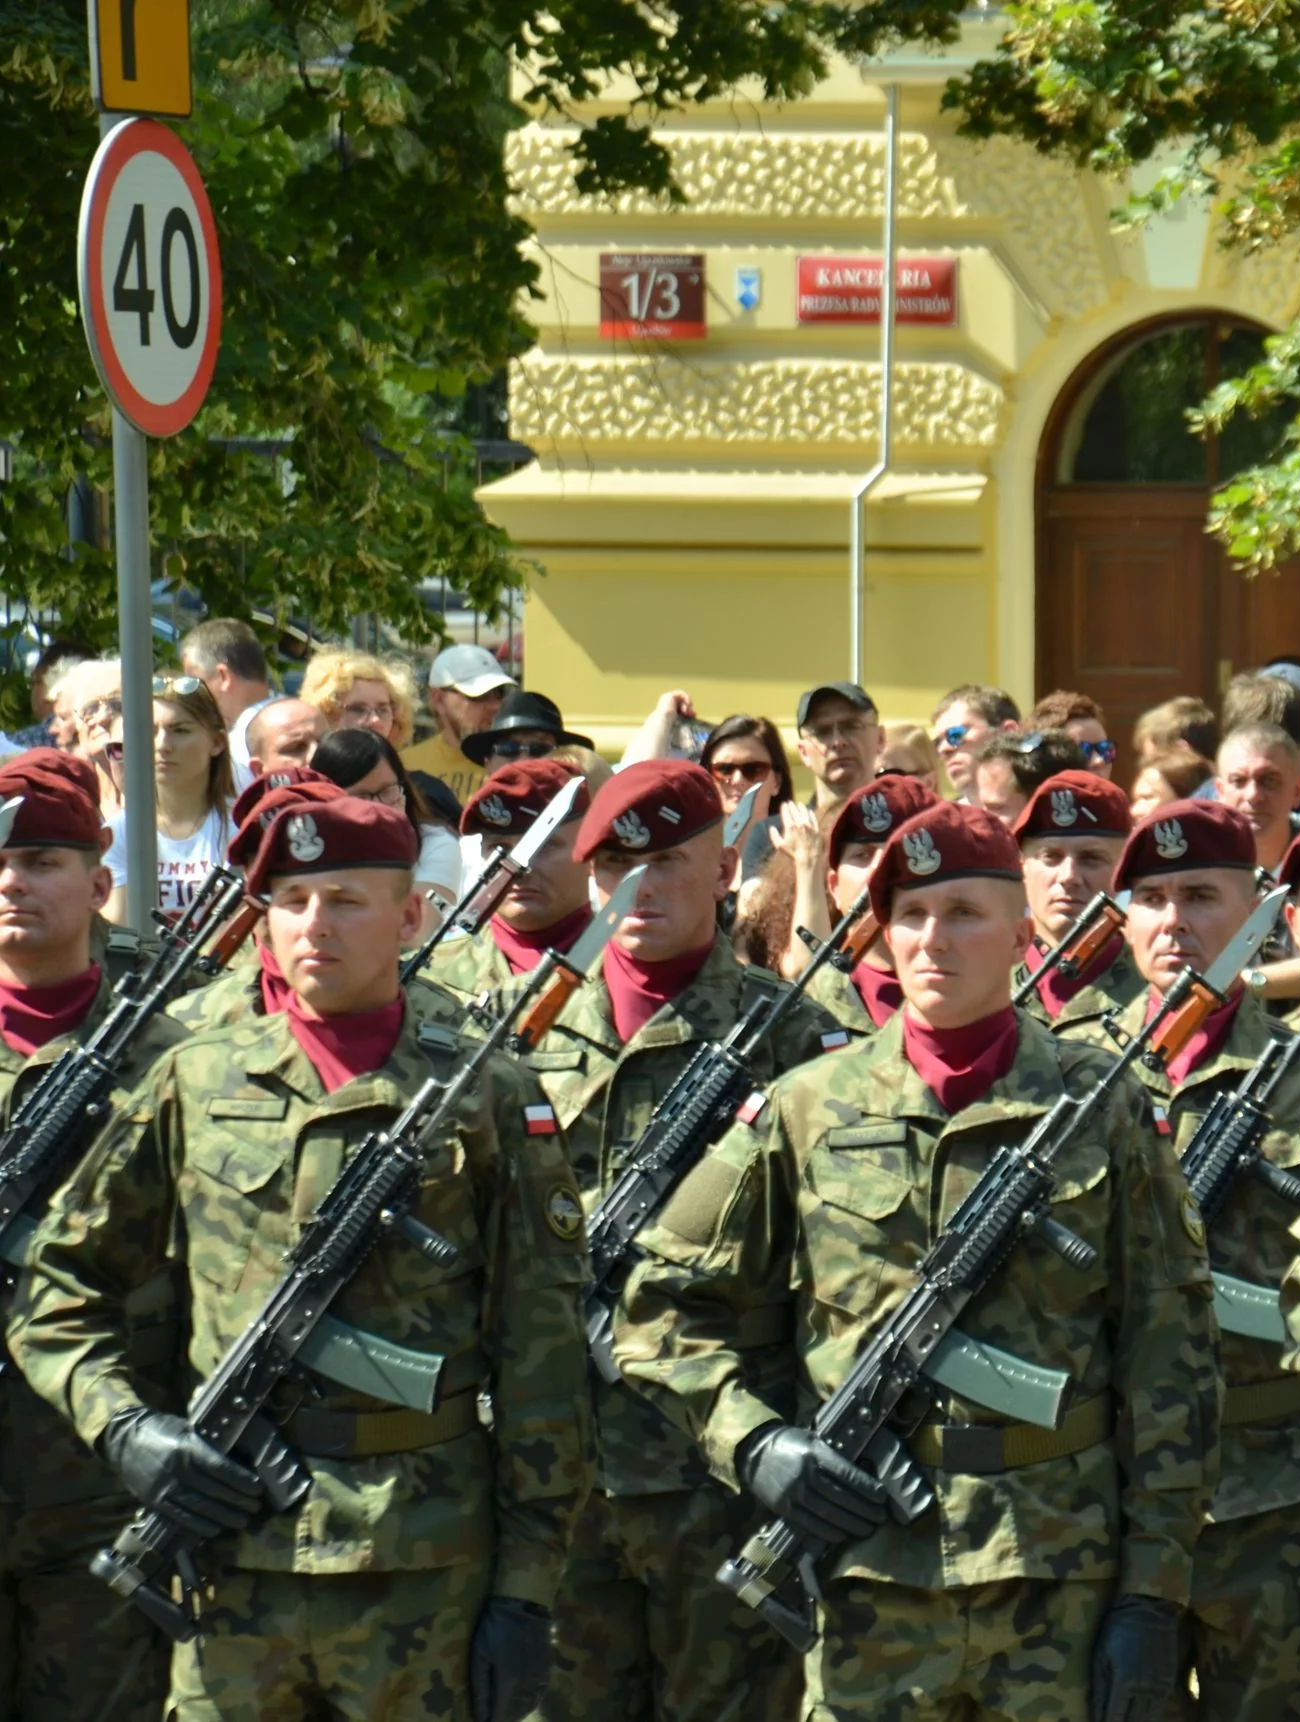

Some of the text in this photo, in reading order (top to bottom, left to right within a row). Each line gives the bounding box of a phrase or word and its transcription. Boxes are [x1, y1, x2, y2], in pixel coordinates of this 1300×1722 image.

[113, 203, 199, 349] 40
[622, 268, 681, 322] 1/3
[895, 292, 952, 312] INISTRÓW
